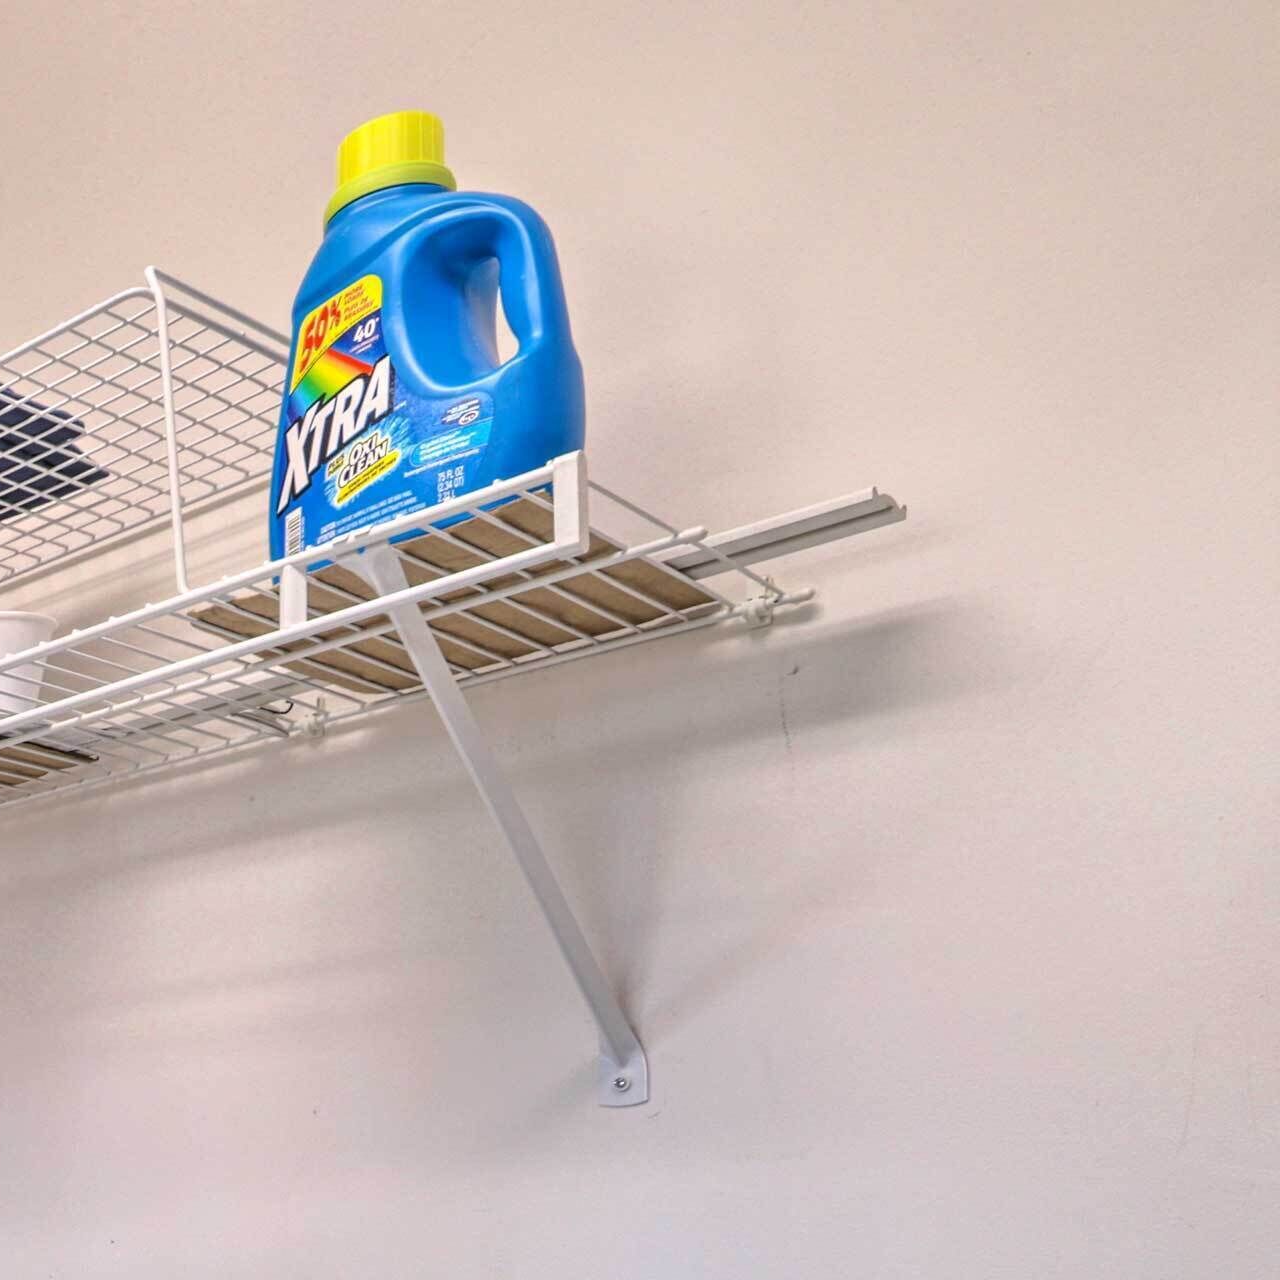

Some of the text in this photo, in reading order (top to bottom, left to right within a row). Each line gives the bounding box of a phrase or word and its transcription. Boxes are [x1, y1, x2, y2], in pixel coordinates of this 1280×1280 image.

[300, 296, 342, 373] 50%
[276, 354, 393, 516] XTRA
[338, 438, 389, 488] CLEAN
[349, 432, 378, 464] OXI
